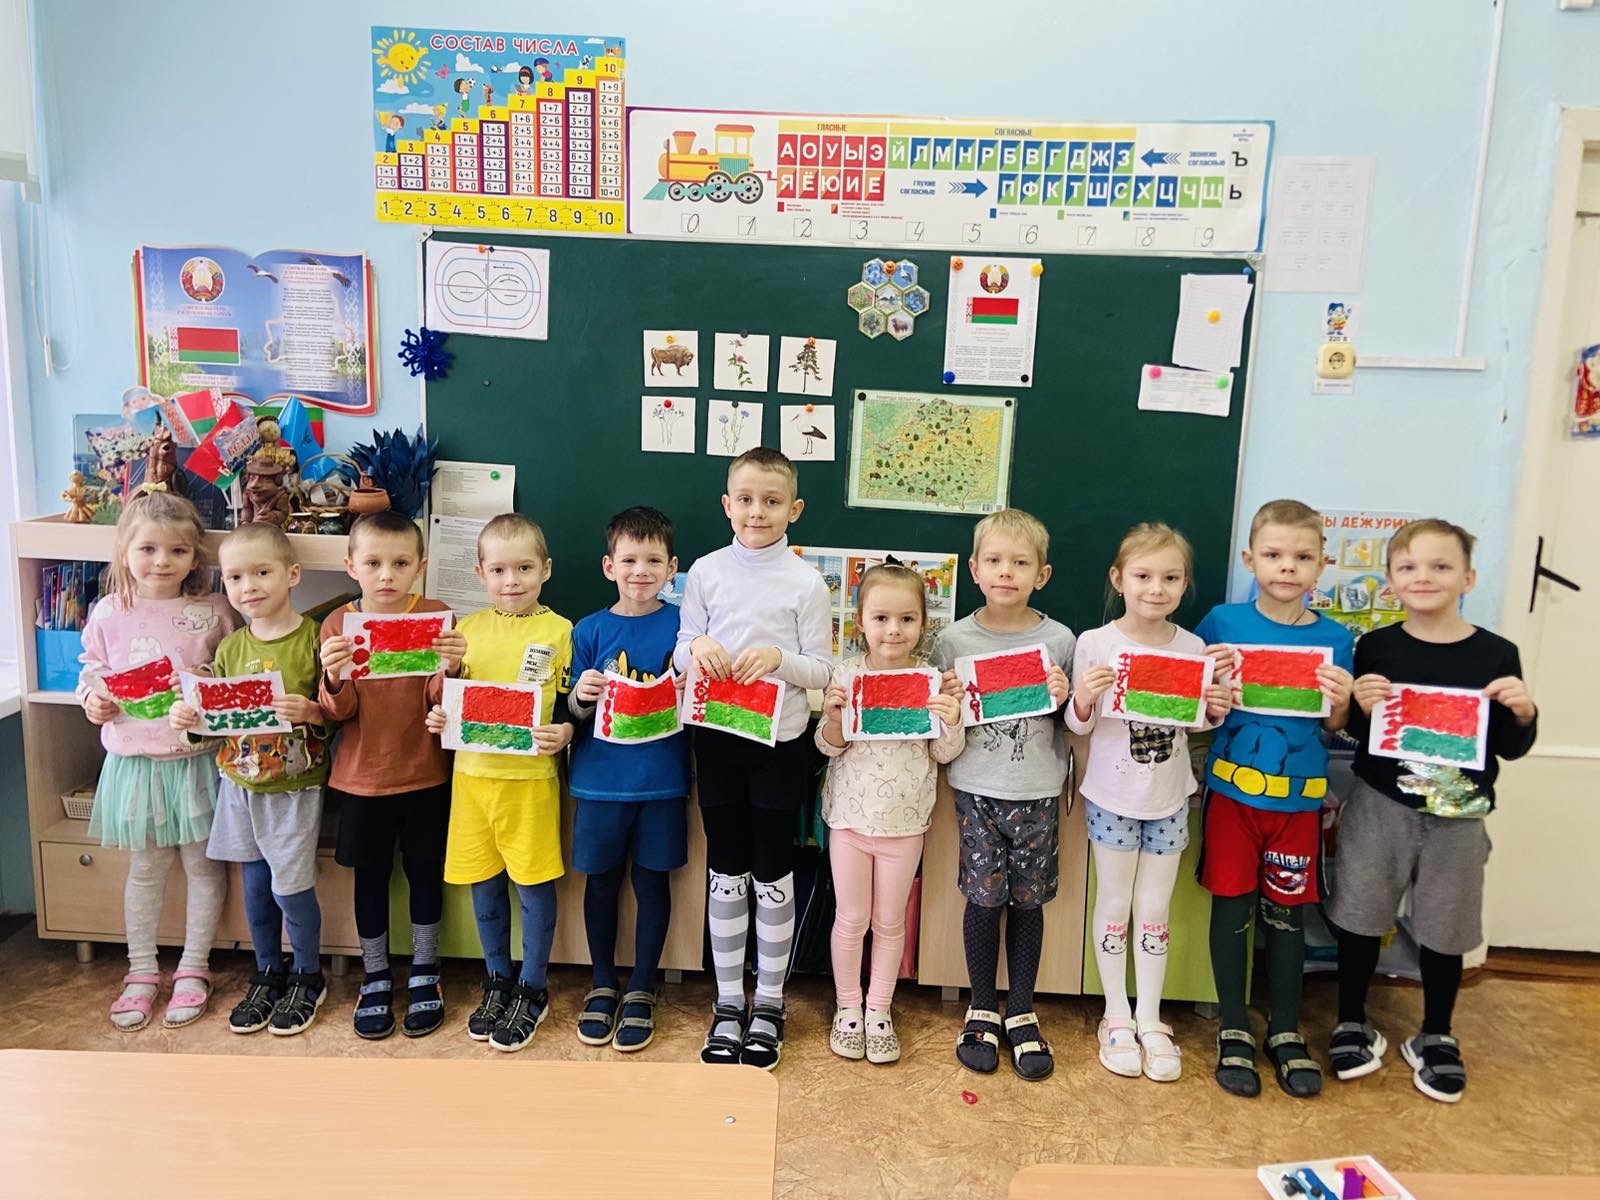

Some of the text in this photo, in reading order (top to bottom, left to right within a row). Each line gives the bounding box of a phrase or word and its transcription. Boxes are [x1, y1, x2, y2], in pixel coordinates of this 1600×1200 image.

[431, 36, 578, 55] СОСТАВ ЧИСЛА
[605, 64, 615, 72] 10
[577, 76, 582, 84] 9
[548, 88, 553, 96] 8
[491, 110, 495, 118] 6
[780, 143, 883, 160] А О У Ы Э
[892, 141, 1130, 168] Й Л М Н Р Б В Г Д Ж З
[1232, 151, 1248, 166] Ъ
[780, 172, 880, 193] Я Ё Ю И Е
[1002, 179, 1222, 202] П Ф К Т Ш С Х Ц Ч Щ
[1230, 185, 1241, 199] Ь
[384, 201, 613, 225] 1 2 3 4 5 6 7 8 9 10
[687, 214, 699, 232] 0
[747, 216, 755, 235] 1
[801, 218, 812, 238] 2
[856, 221, 868, 240] 3
[914, 221, 924, 240] 4
[968, 224, 980, 242] 5
[1025, 225, 1038, 244] 6
[1084, 227, 1096, 245] 7
[1142, 227, 1155, 246] 8
[1201, 227, 1213, 247] 9
[1324, 517, 1336, 528] Ы
